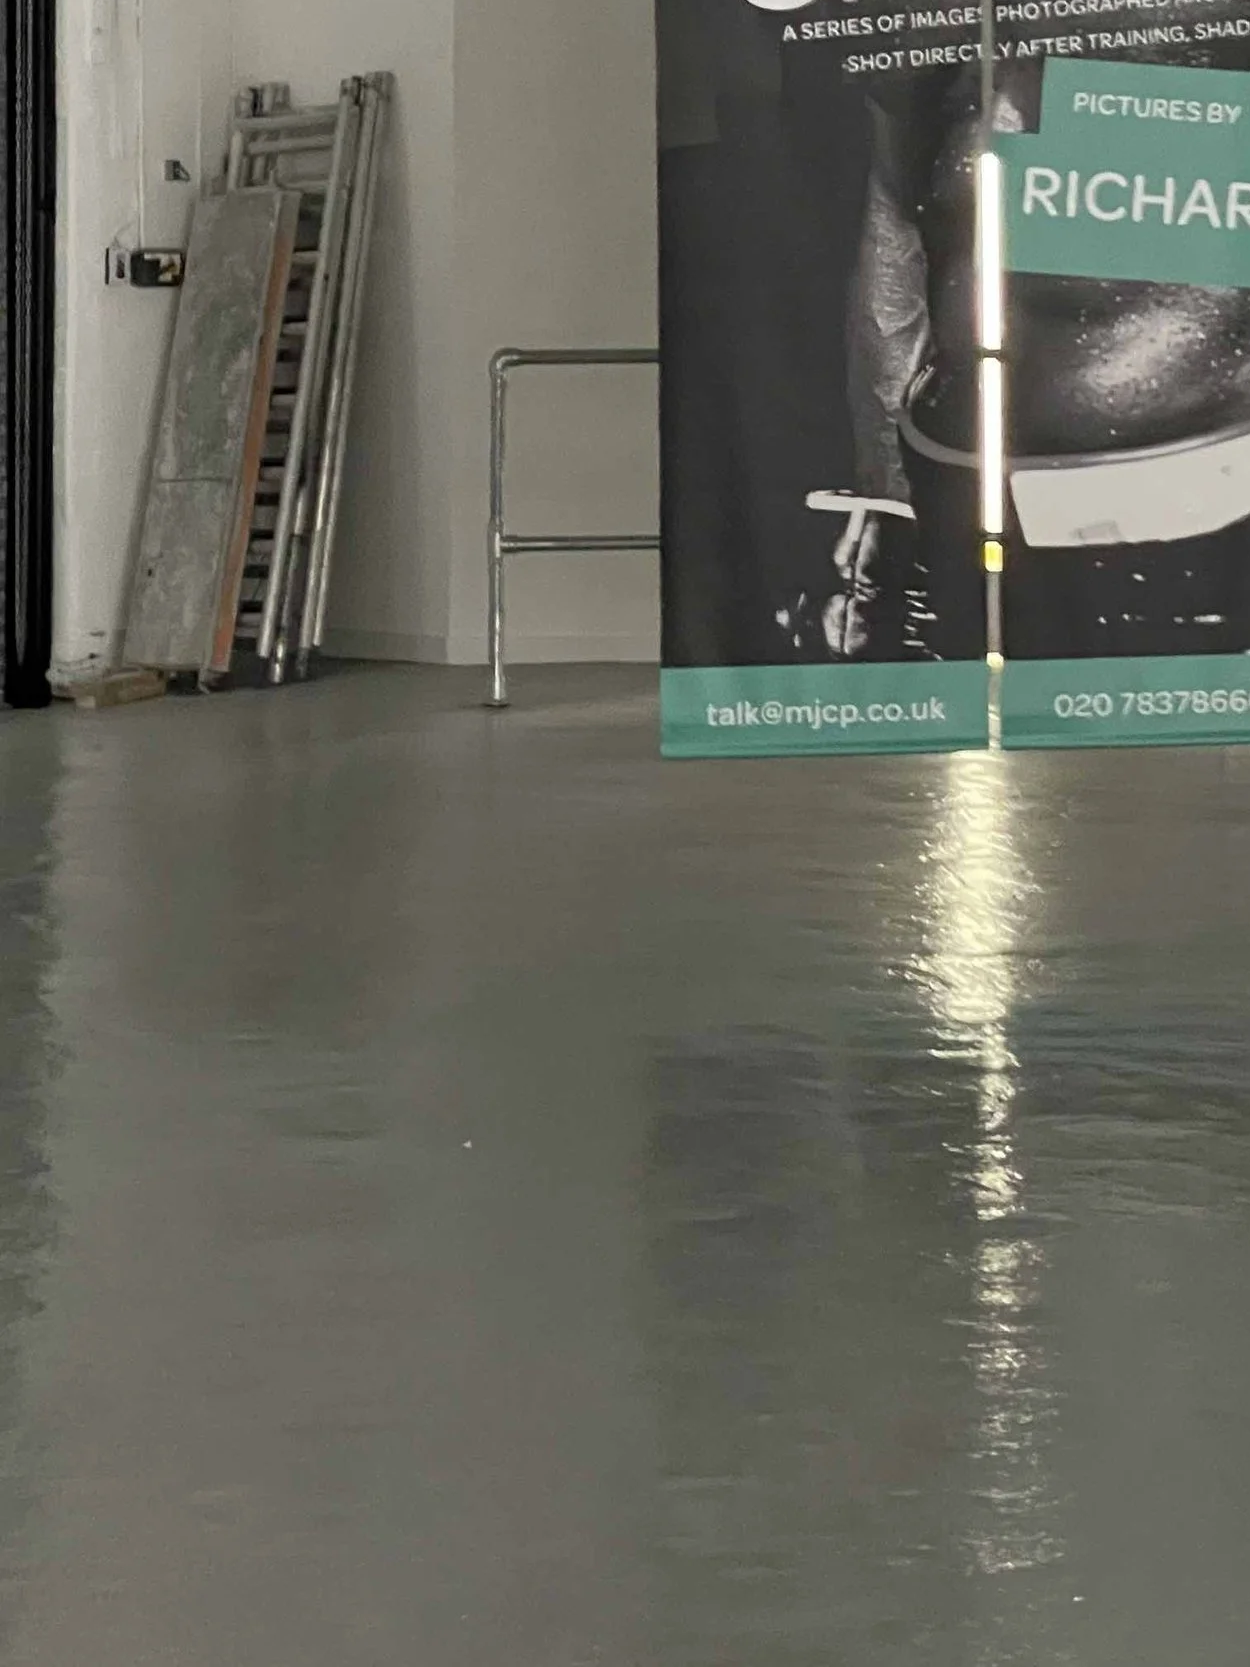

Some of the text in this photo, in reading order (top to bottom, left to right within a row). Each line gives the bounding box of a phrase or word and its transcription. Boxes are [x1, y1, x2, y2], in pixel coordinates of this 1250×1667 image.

[783, 24, 798, 41] A
[801, 17, 872, 39] SERIES
[877, 13, 906, 33] OF
[910, 41, 1011, 67] DIRECTY
[1016, 35, 1083, 58] AFTER
[1073, 92, 1242, 124] PICTURES BY
[706, 695, 946, 730] talk@mjcp.co.uk
[1054, 692, 1113, 718] 020
